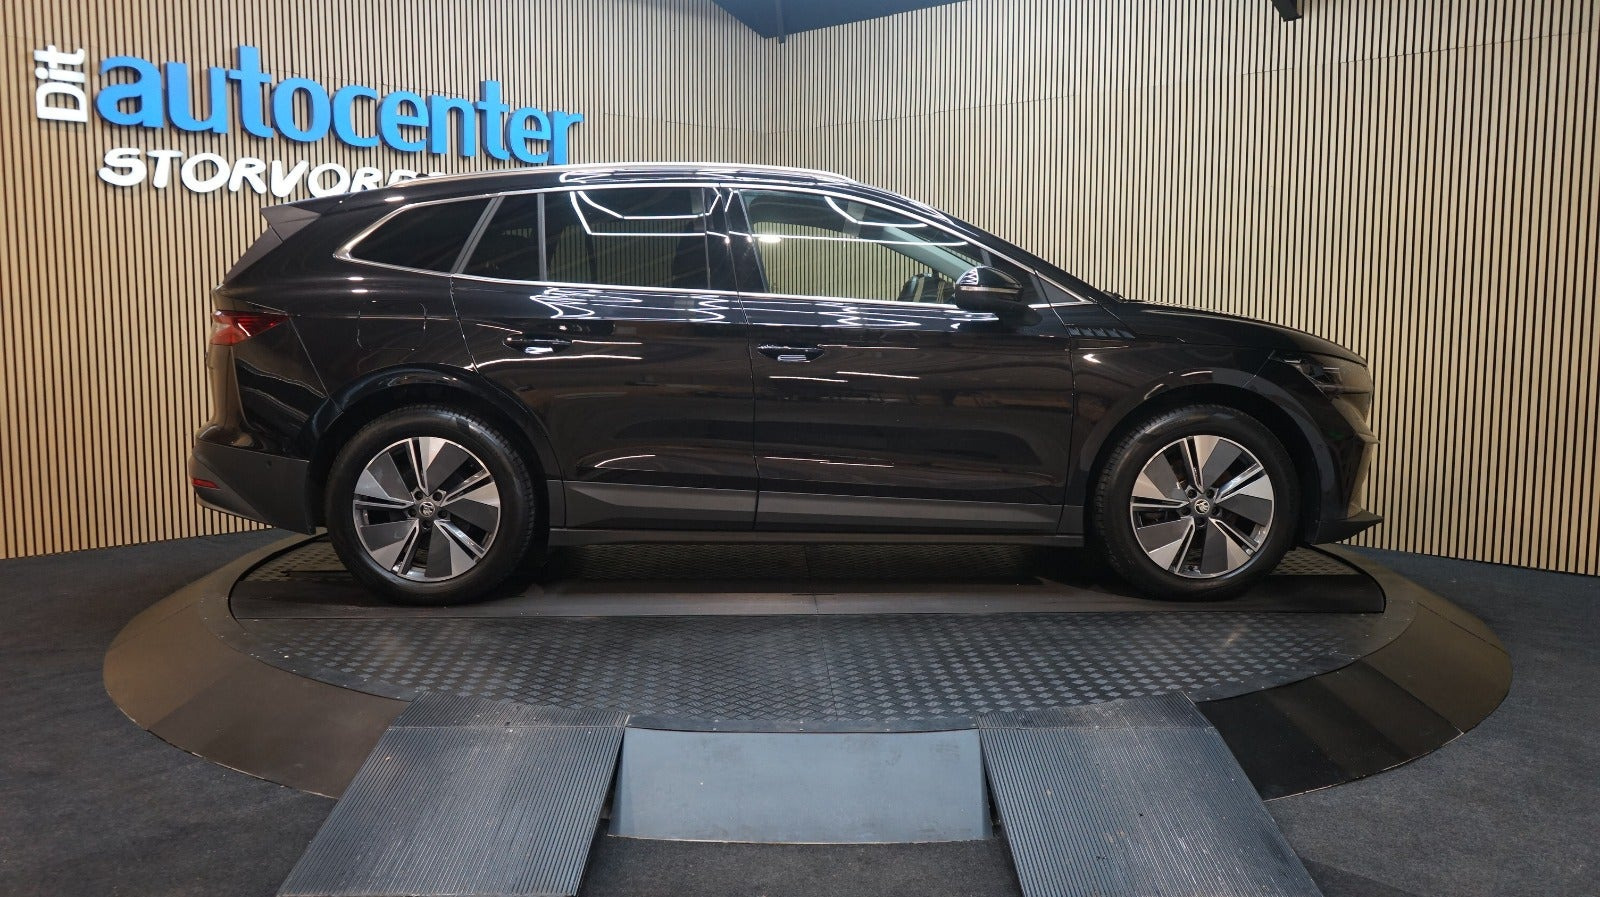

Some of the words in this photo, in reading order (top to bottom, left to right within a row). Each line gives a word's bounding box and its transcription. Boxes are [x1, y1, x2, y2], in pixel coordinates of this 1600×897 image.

[34, 44, 88, 123] Dit
[96, 45, 584, 165] autocenter
[98, 147, 447, 198] STORVOR
